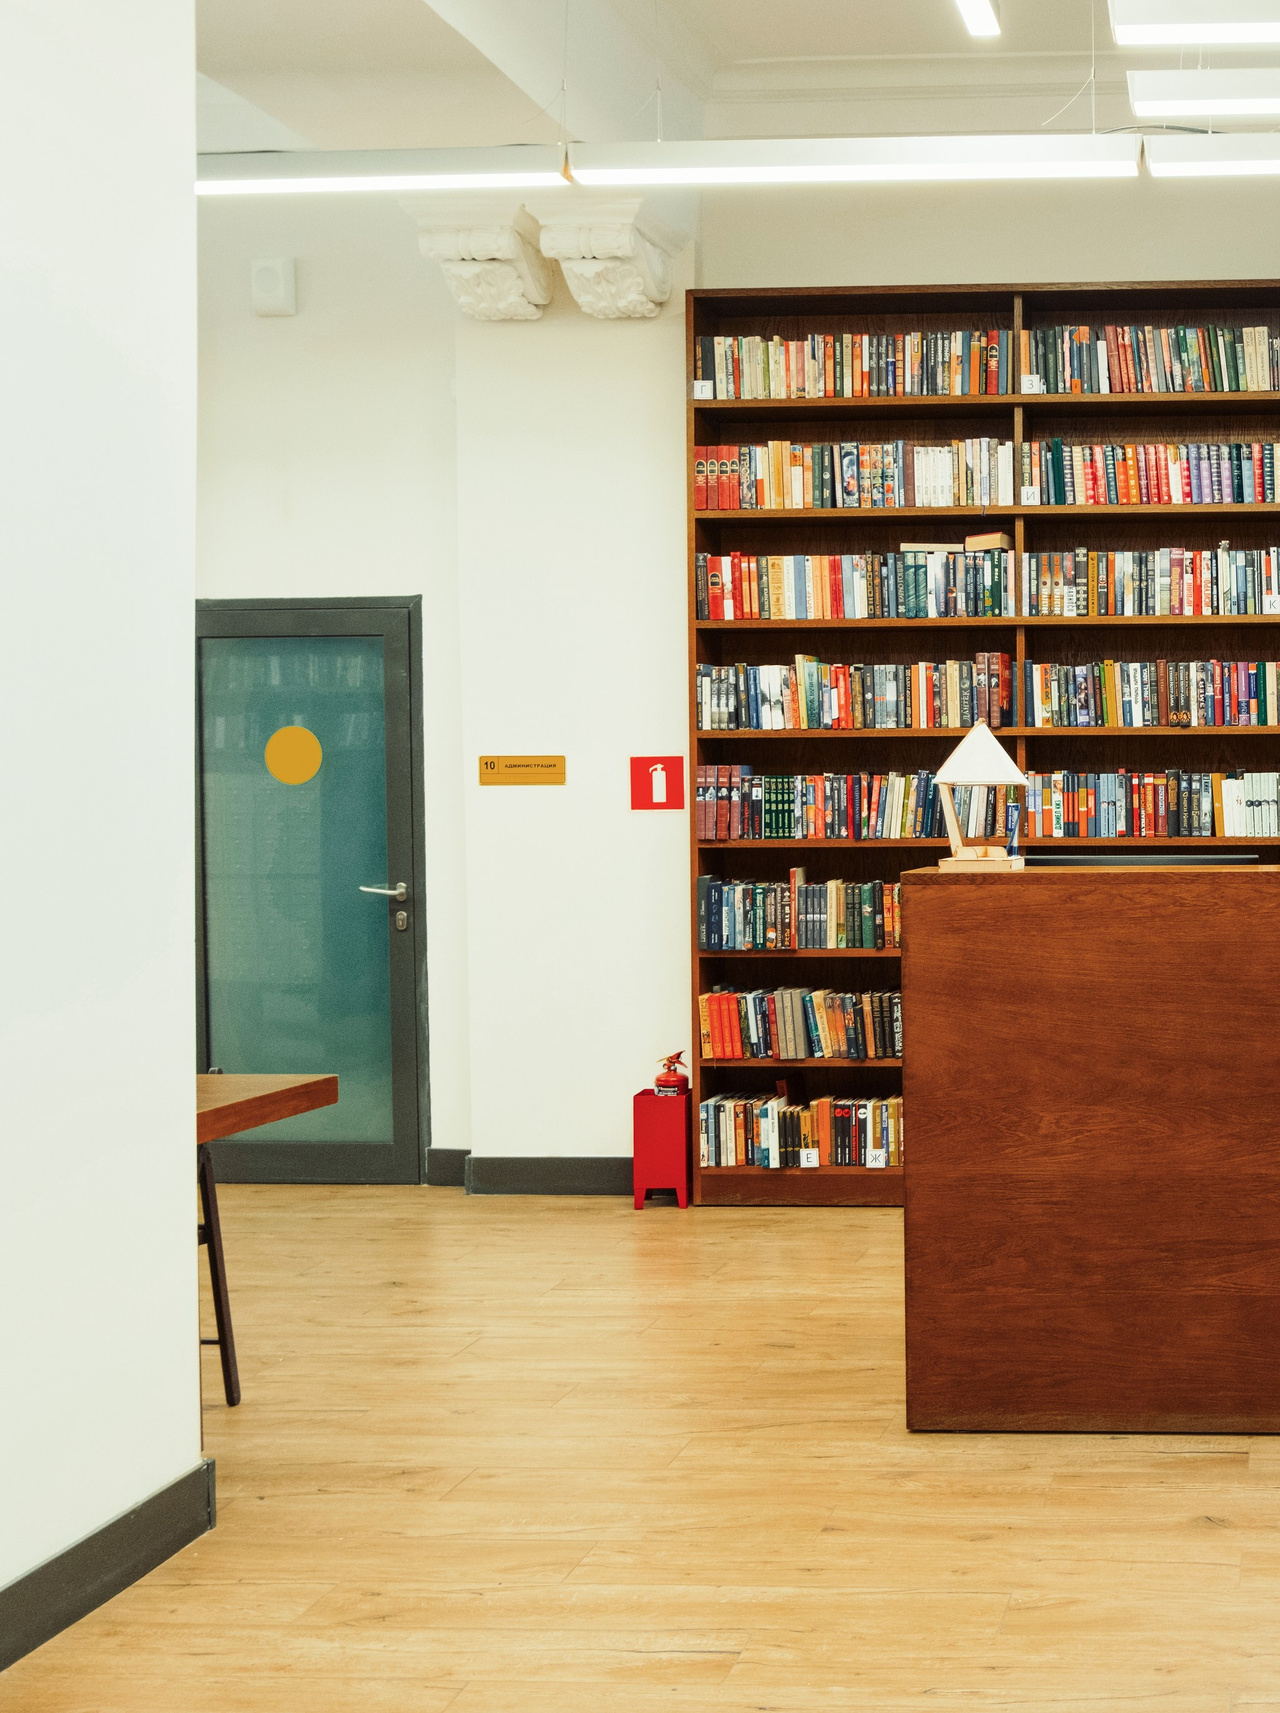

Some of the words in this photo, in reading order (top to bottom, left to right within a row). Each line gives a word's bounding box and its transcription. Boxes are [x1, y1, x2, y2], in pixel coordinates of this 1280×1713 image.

[1027, 379, 1034, 390] З
[1026, 491, 1036, 501] И
[1269, 599, 1276, 610] К
[484, 761, 496, 770] 10
[1054, 811, 1062, 830] ДЭНИЕЛ
[806, 1153, 812, 1163] Е
[870, 1153, 882, 1163] Ж
